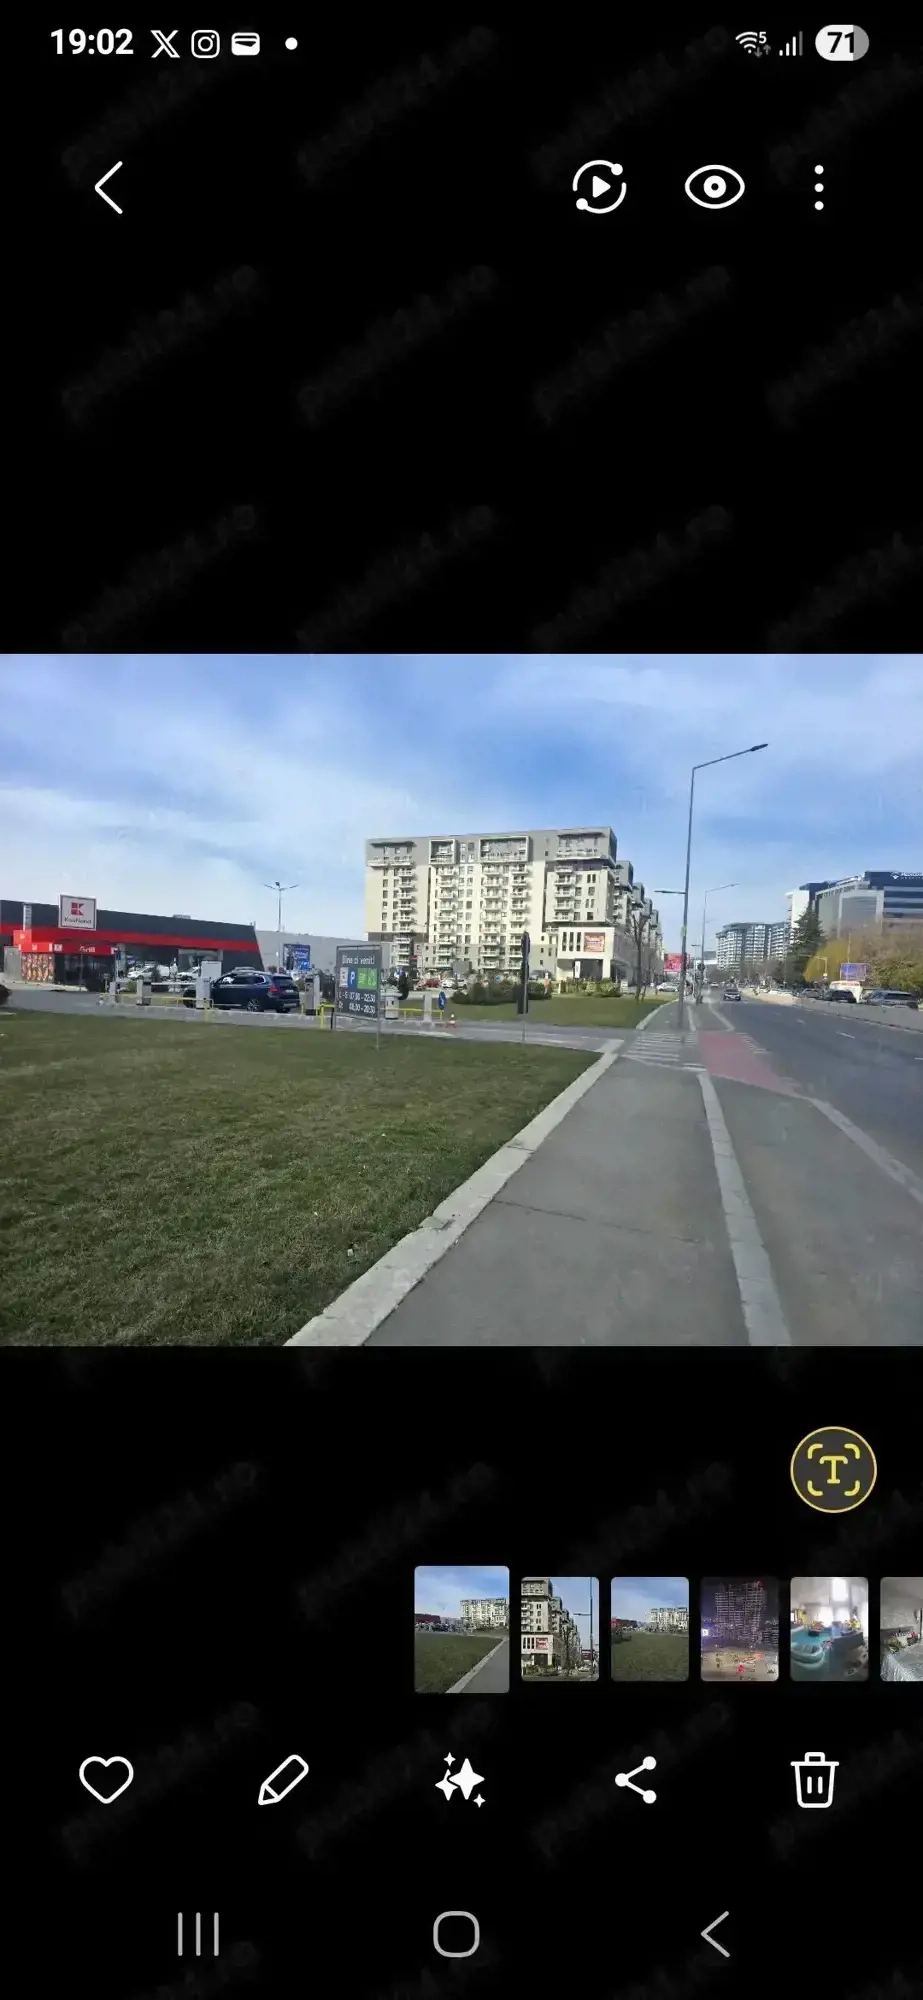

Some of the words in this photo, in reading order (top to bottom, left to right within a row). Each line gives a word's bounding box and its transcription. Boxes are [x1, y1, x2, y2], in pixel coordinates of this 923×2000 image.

[51, 29, 133, 54] 19:02
[828, 32, 854, 53] 71
[350, 972, 355, 984] P
